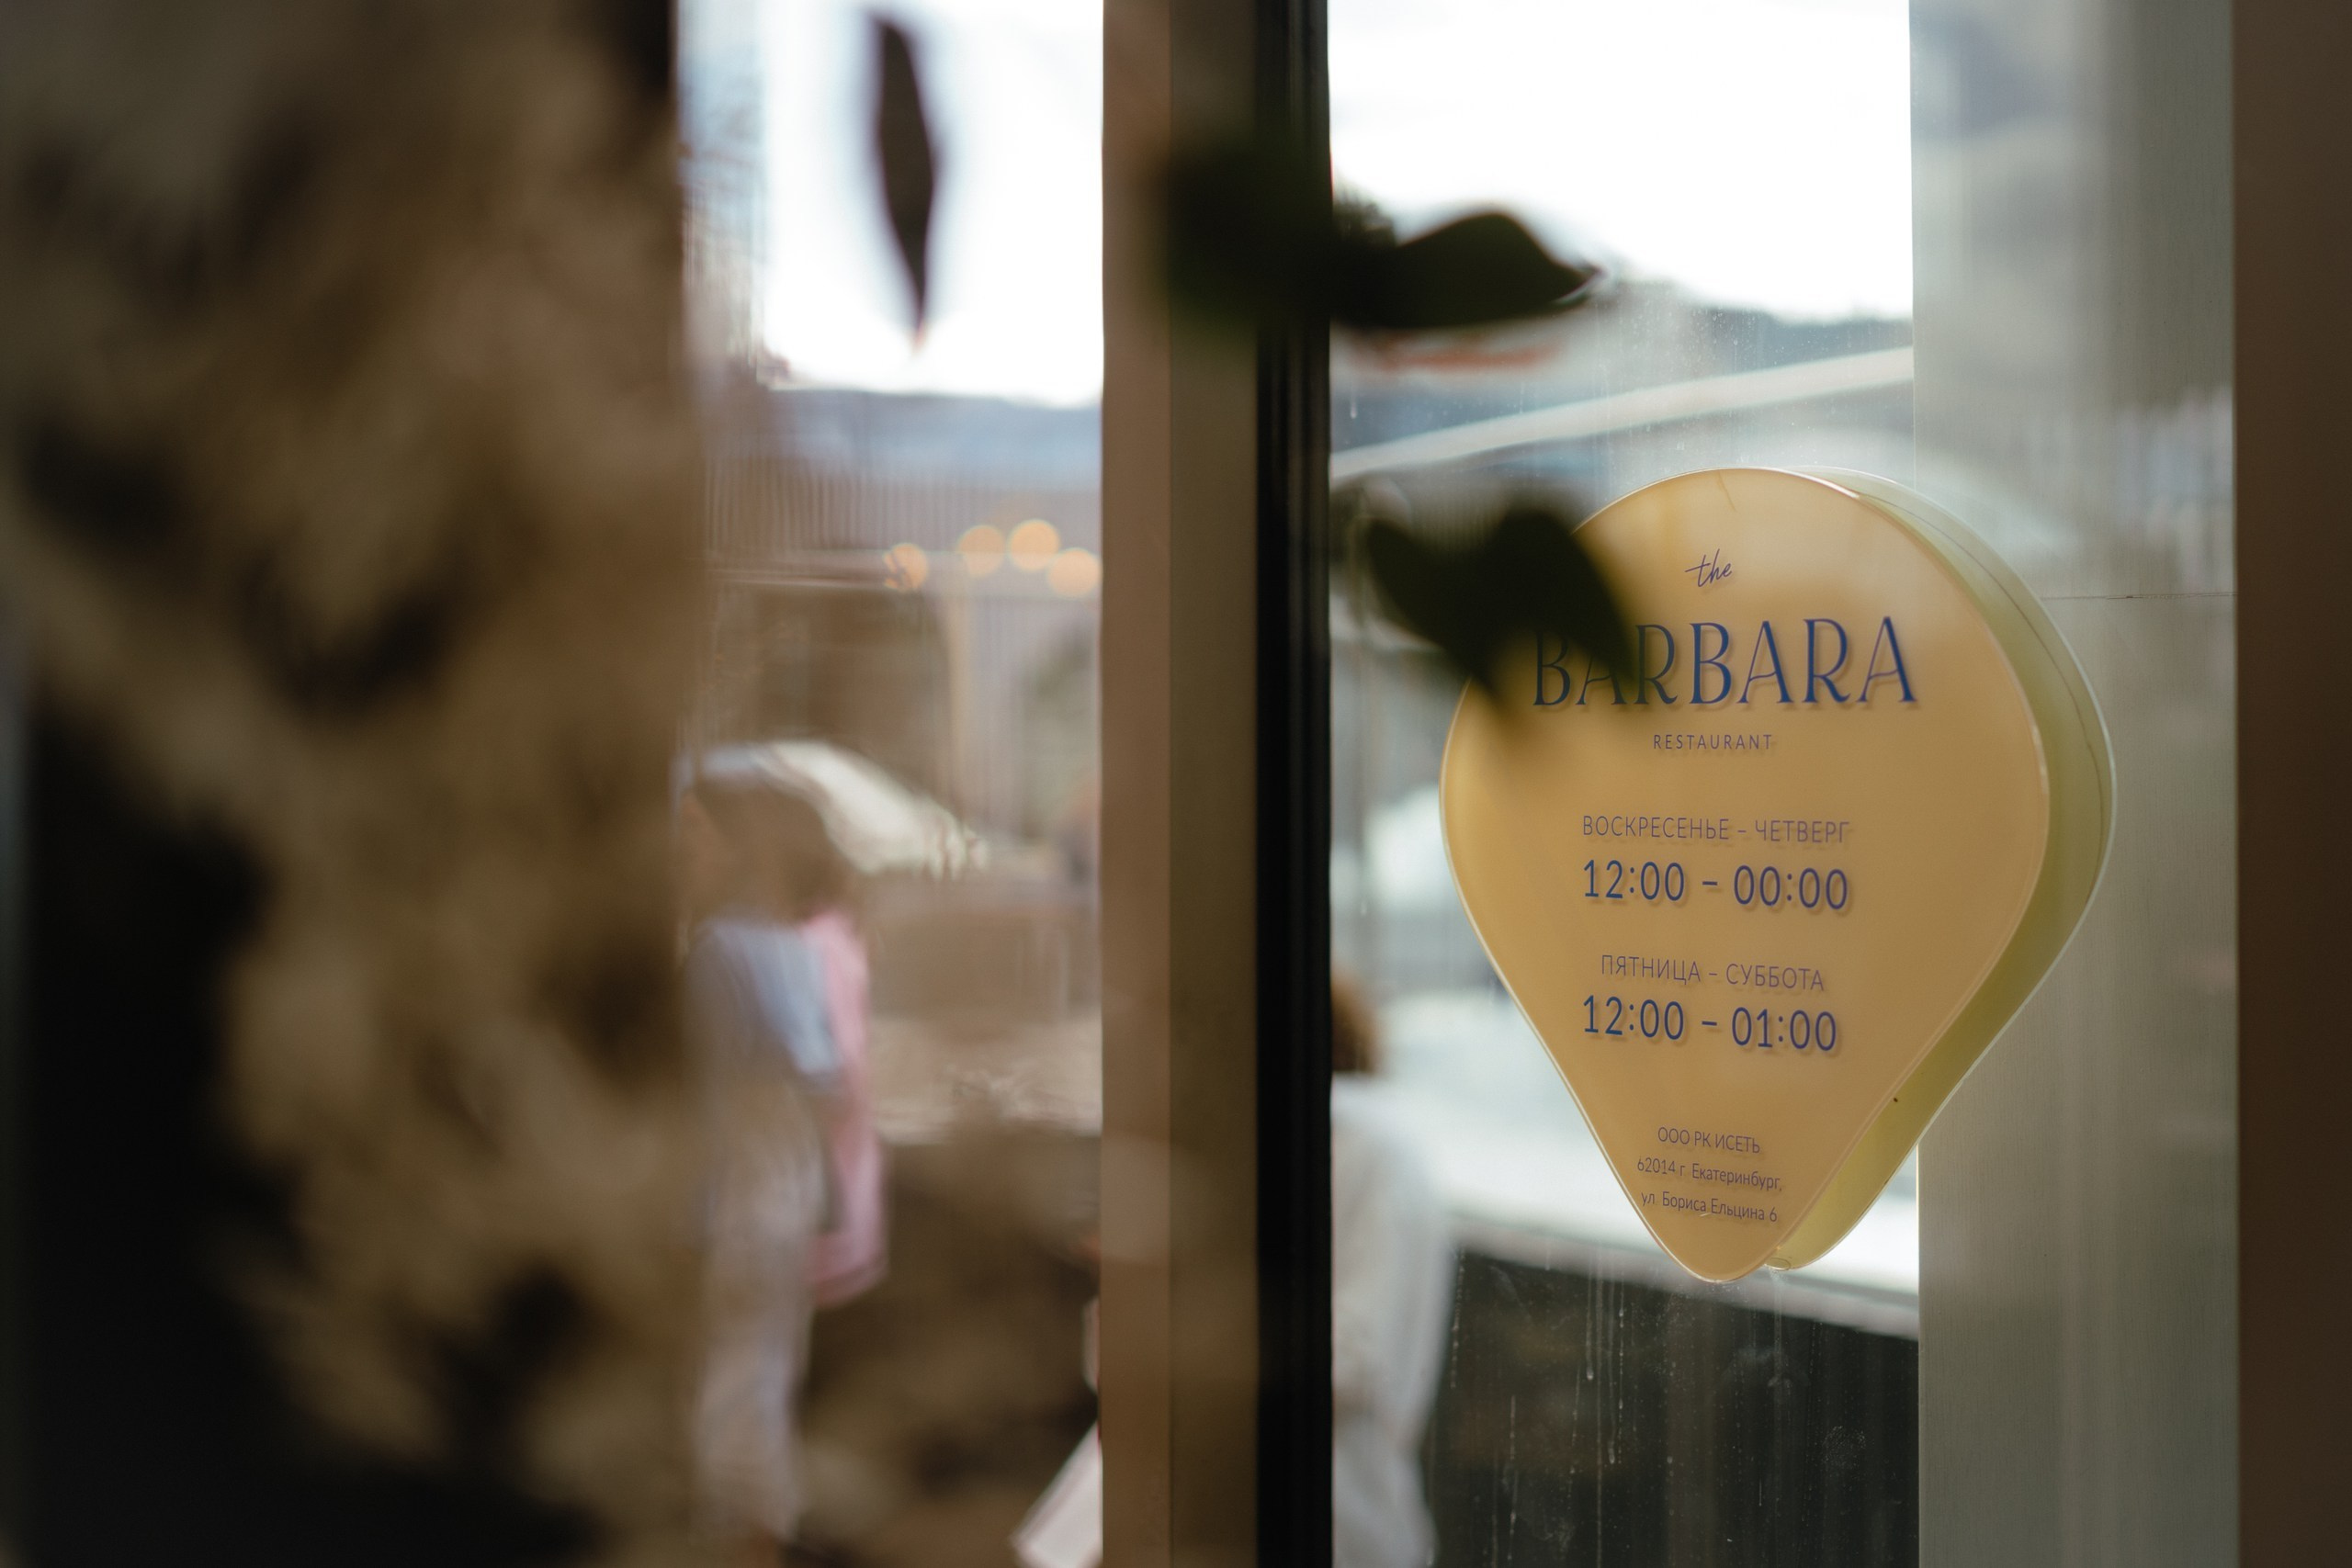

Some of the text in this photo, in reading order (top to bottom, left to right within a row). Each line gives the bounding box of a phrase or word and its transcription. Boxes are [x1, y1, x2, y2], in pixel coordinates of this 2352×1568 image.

[1685, 548, 1733, 588] the
[1532, 616, 1917, 706] BARBARA
[1654, 734, 1772, 750] RESTAURANT
[1583, 816, 1729, 840] ВОСКРЕСЕНЬЕ
[1755, 819, 1850, 843] ЧЕТВЕРГ
[1583, 859, 1685, 901] 12:00
[1734, 864, 1848, 909] 00:00
[1601, 954, 1701, 985] ПЯТНИЦА
[1725, 964, 1824, 990] СУББОТА
[1583, 995, 1684, 1040] 12:00
[1732, 1007, 1837, 1051] 01:00
[1657, 1126, 1760, 1154] ООО РК ИСЕТЬ
[1637, 1156, 1676, 1175] 62014
[1692, 1163, 1782, 1192] Екатеринбург,
[1662, 1191, 1706, 1212] Бориса
[1711, 1198, 1765, 1221] Ельцина
[1770, 1207, 1778, 1223] 6
